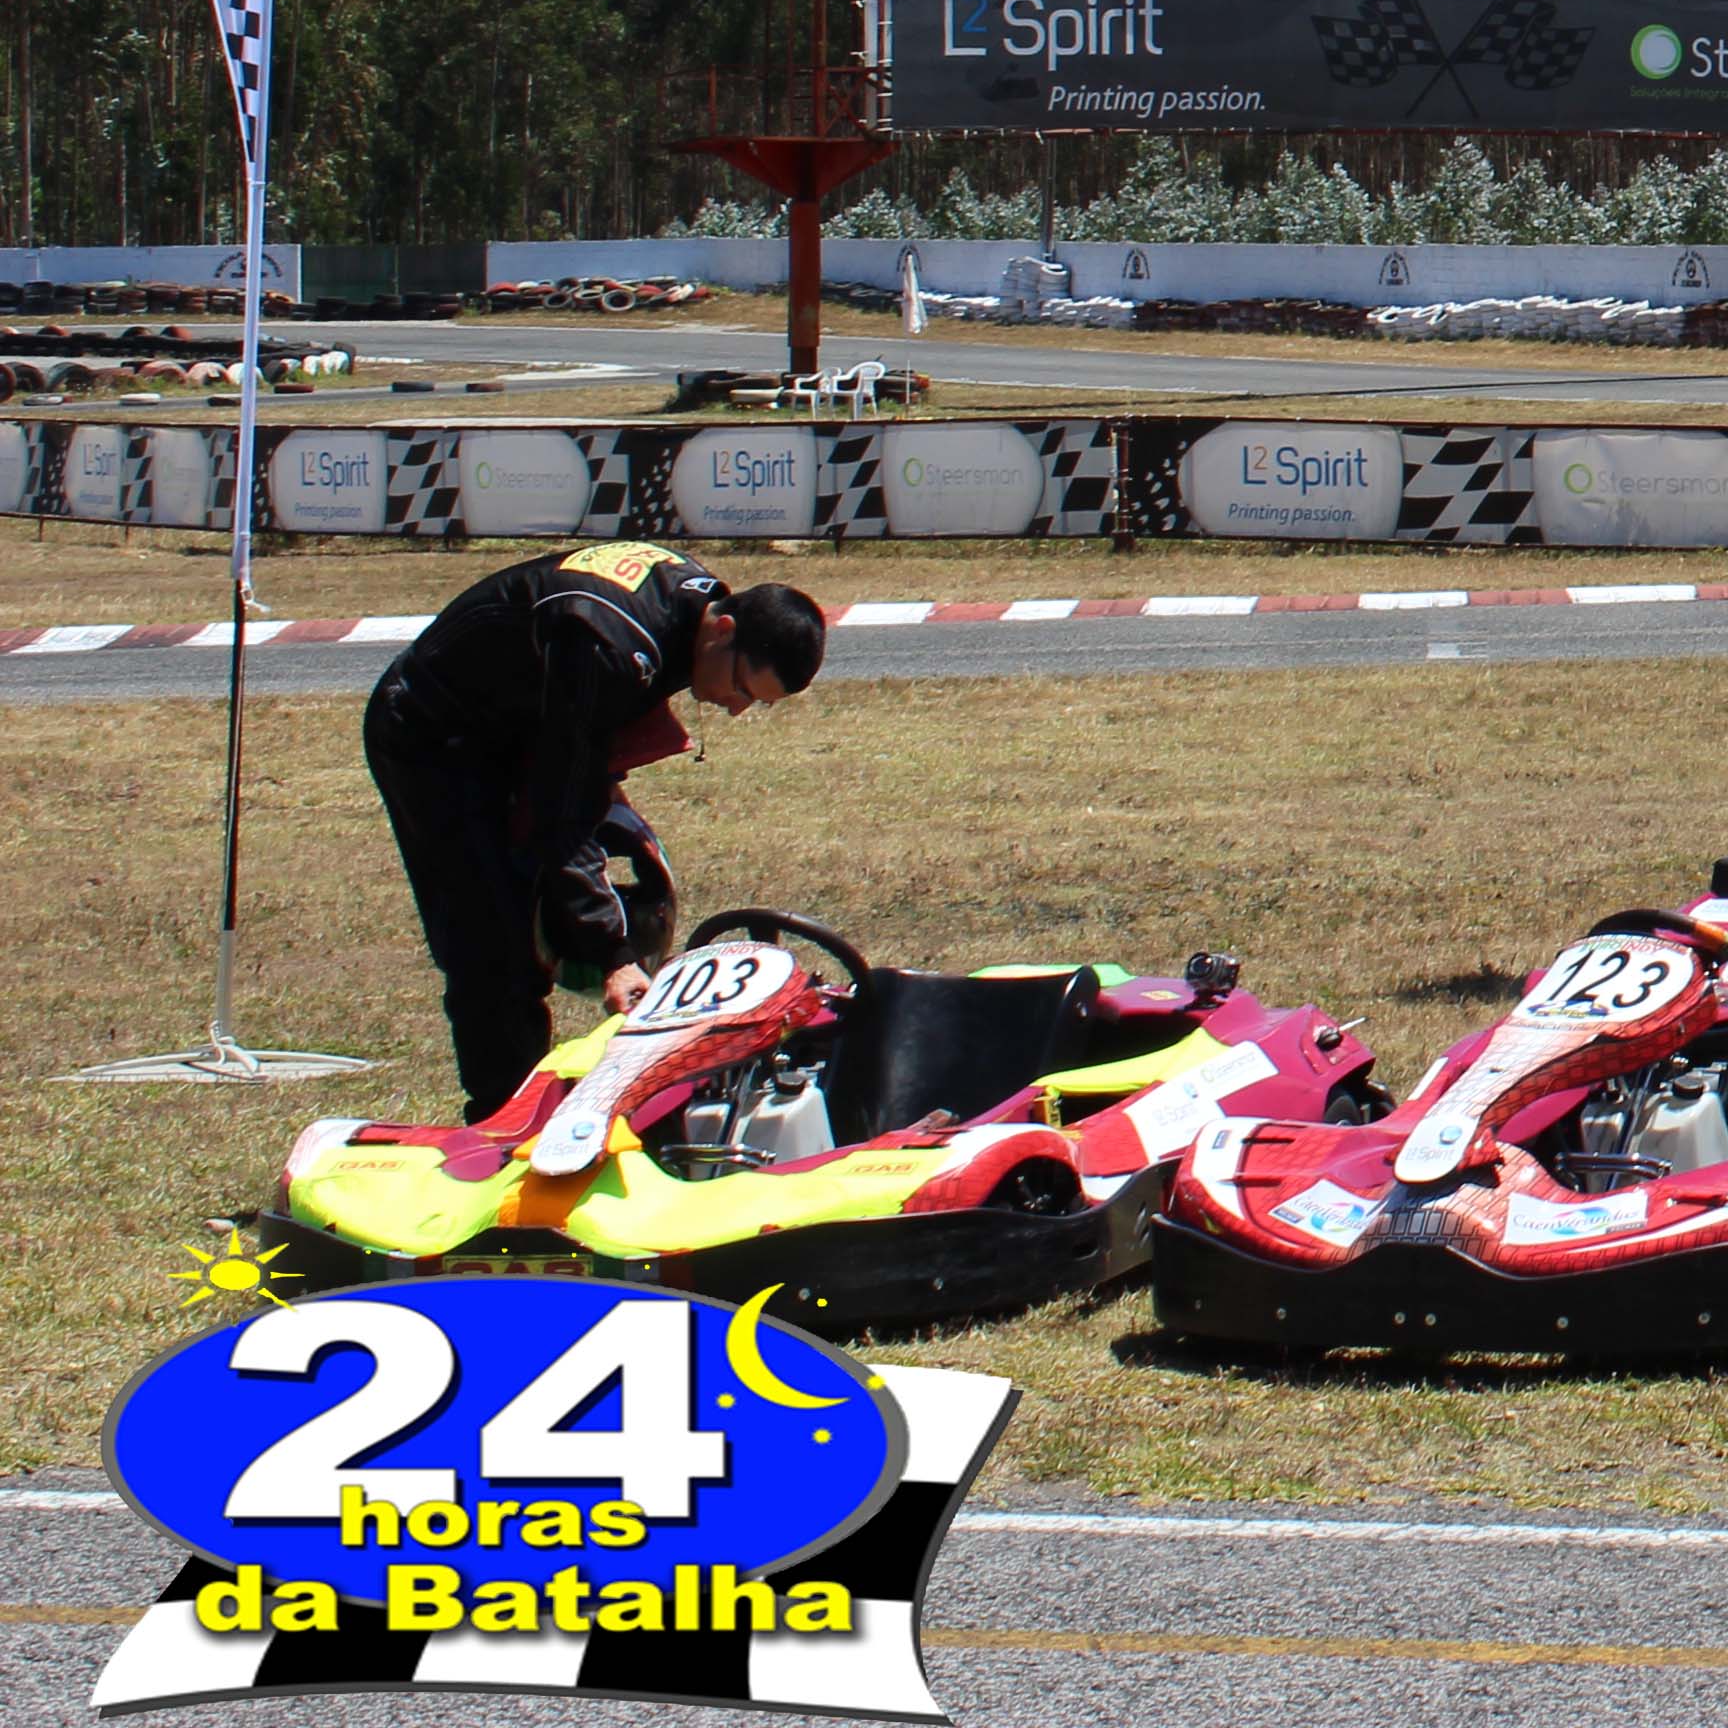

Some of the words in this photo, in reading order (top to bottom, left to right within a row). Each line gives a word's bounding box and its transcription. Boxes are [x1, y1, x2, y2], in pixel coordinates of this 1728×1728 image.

[1048, 85, 1154, 119] Printing
[1159, 85, 1267, 119] passion.
[735, 450, 795, 496] Spirit
[1276, 447, 1368, 496] Spirit
[1228, 502, 1290, 526] Printing
[650, 957, 761, 1013] 103
[1546, 949, 1670, 1009] 123
